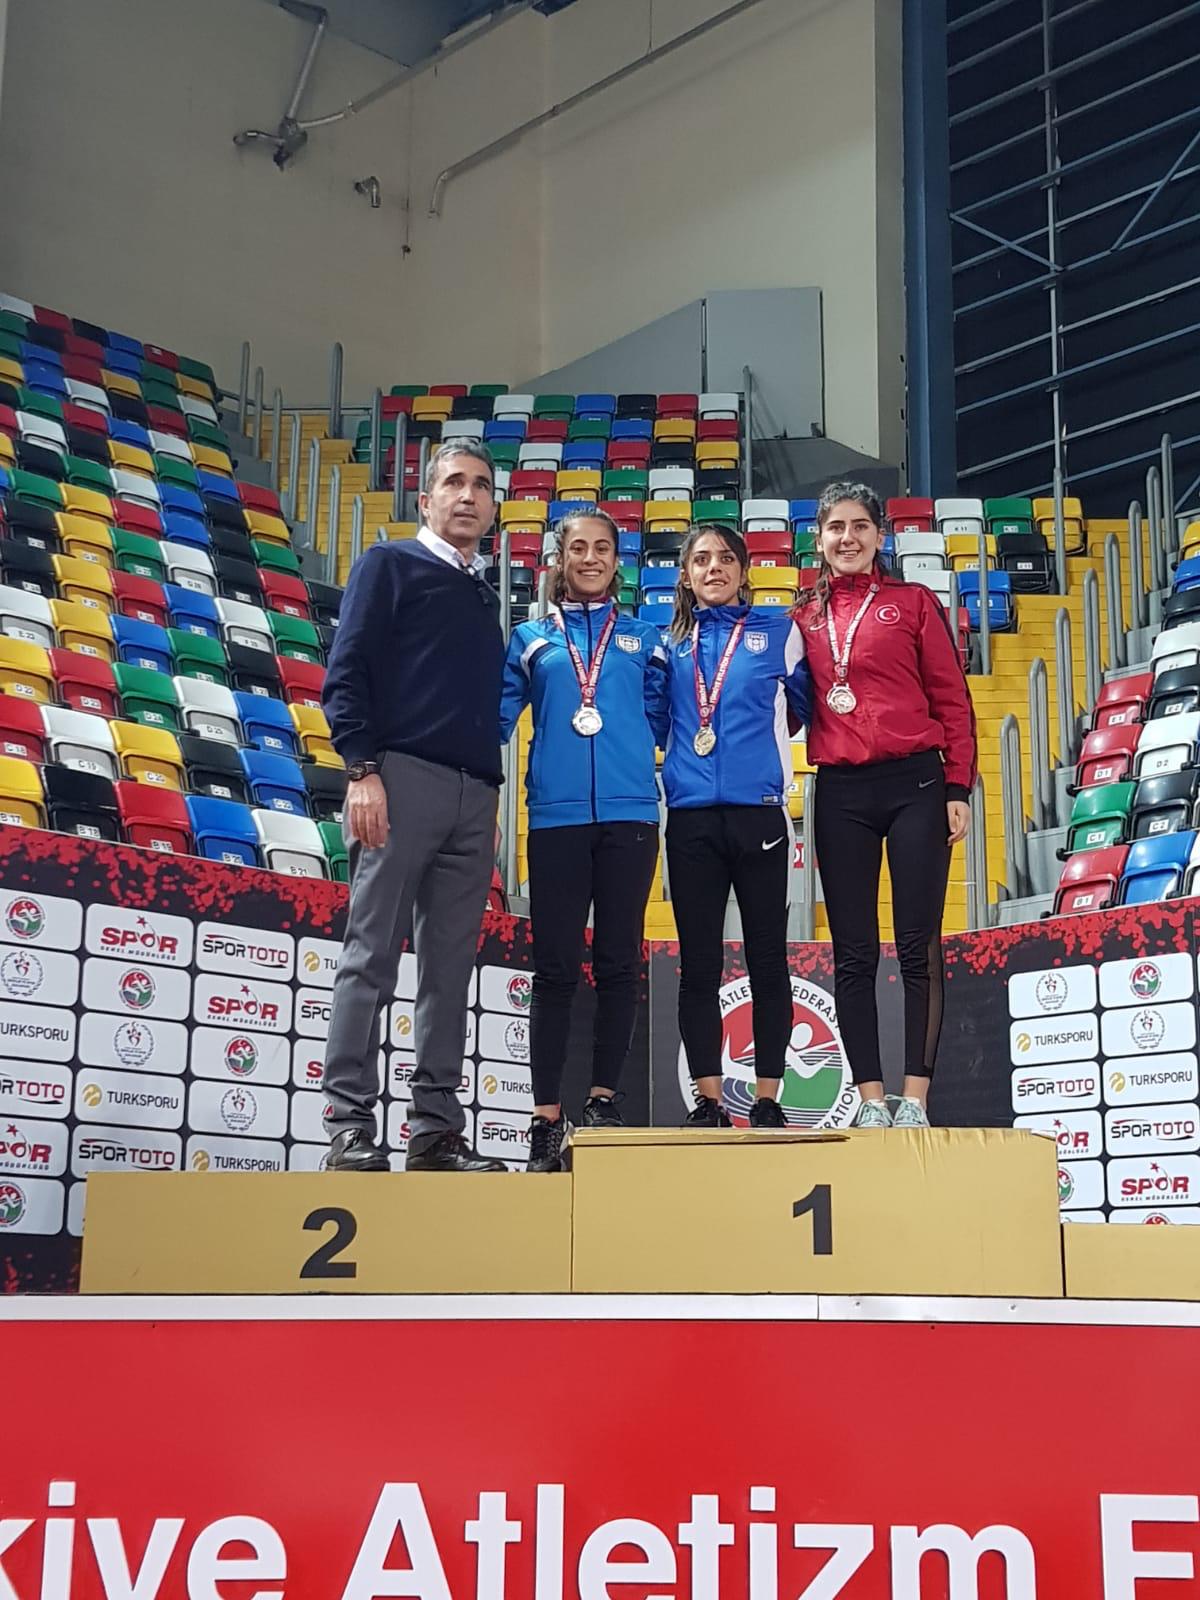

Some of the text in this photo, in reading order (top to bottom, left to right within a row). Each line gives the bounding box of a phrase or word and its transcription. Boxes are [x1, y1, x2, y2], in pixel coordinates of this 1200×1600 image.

[101, 927, 178, 954] SPOR
[208, 996, 279, 1021] SPOR
[793, 984, 840, 1029] EDERAS
[1034, 1030, 1093, 1047] TURKSPORU
[501, 1080, 532, 1095] TURKS
[1129, 1070, 1193, 1087] TURKSPORU
[107, 1090, 179, 1110] TURKSPORU
[214, 1155, 281, 1171] TURKSPORU
[1121, 1176, 1190, 1196] SPOR
[792, 1183, 833, 1256] 1
[299, 1206, 358, 1280] 2
[341, 1482, 1037, 1600] Atletizm
